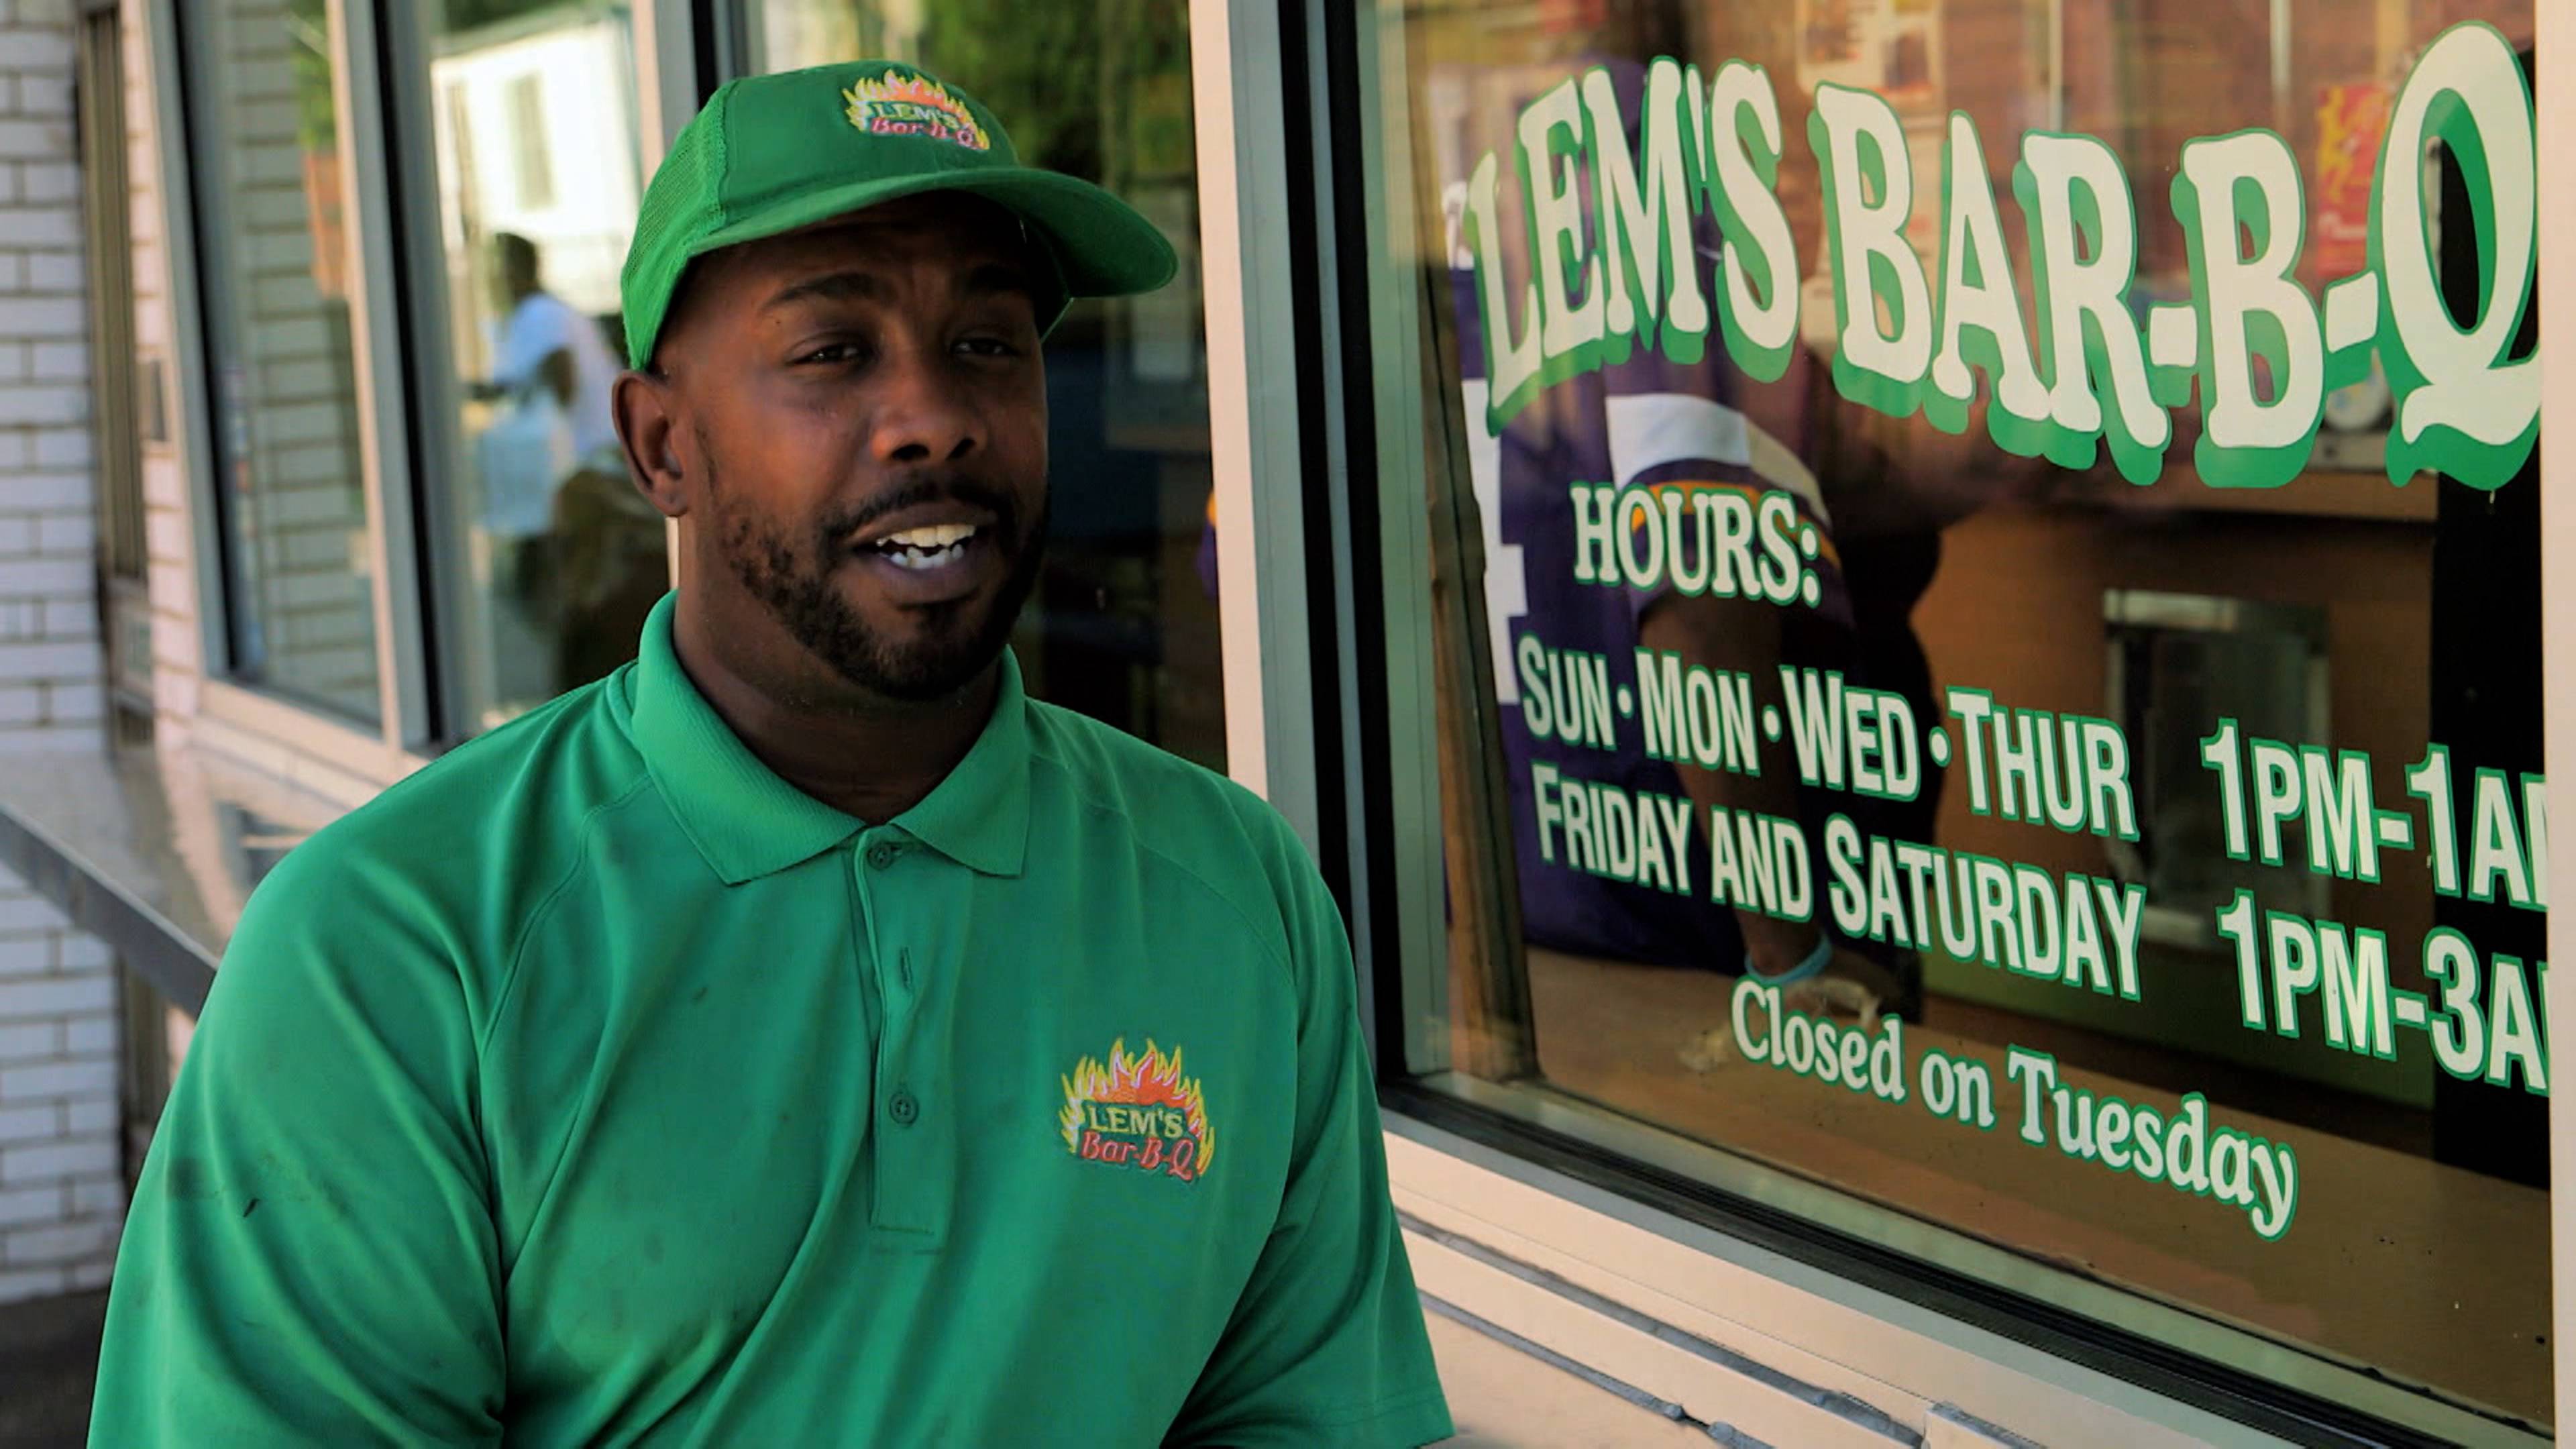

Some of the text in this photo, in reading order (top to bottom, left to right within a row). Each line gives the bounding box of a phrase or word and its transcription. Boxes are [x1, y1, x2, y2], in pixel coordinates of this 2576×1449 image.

[1464, 19, 2542, 491] LEM'S BAR-B-Q
[1570, 482, 1821, 607] HOURS:
[1532, 759, 2550, 1097] FRIDAY AND SATURDAY 1PM-3A
[1081, 1130, 1193, 1181] Bar-B-Q
[1087, 1104, 1183, 1138] LEM'S
[1731, 974, 2298, 1241] Closed on Tuesday
